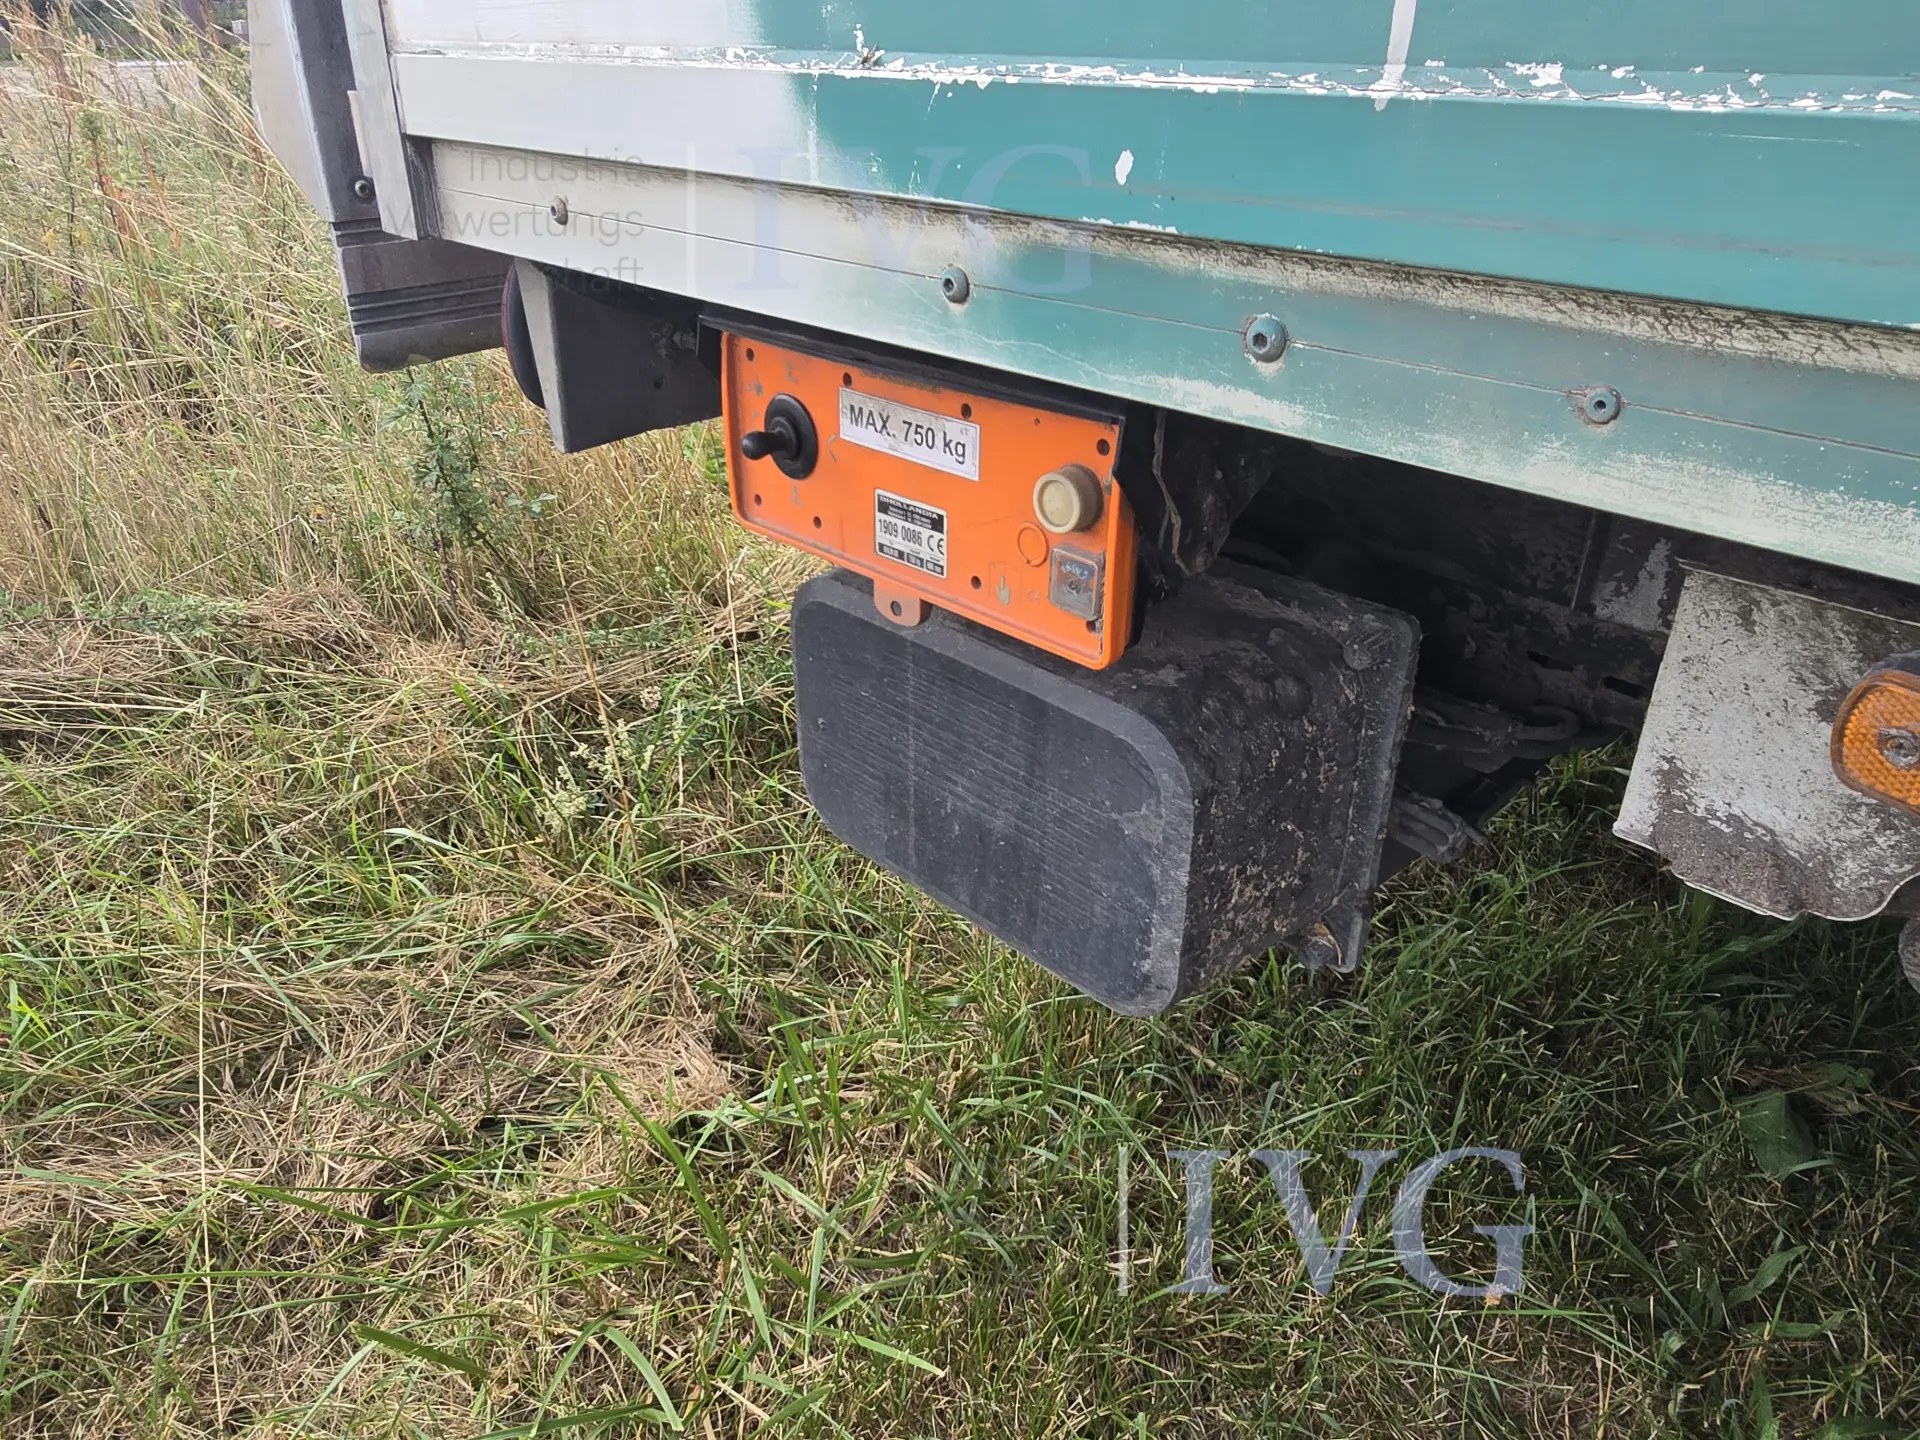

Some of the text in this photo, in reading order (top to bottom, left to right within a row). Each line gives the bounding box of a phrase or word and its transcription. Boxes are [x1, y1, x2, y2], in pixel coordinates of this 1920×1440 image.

[849, 403, 966, 465] MAX. 750 kg
[878, 518, 899, 538] 1909
[901, 525, 923, 547] 0086
